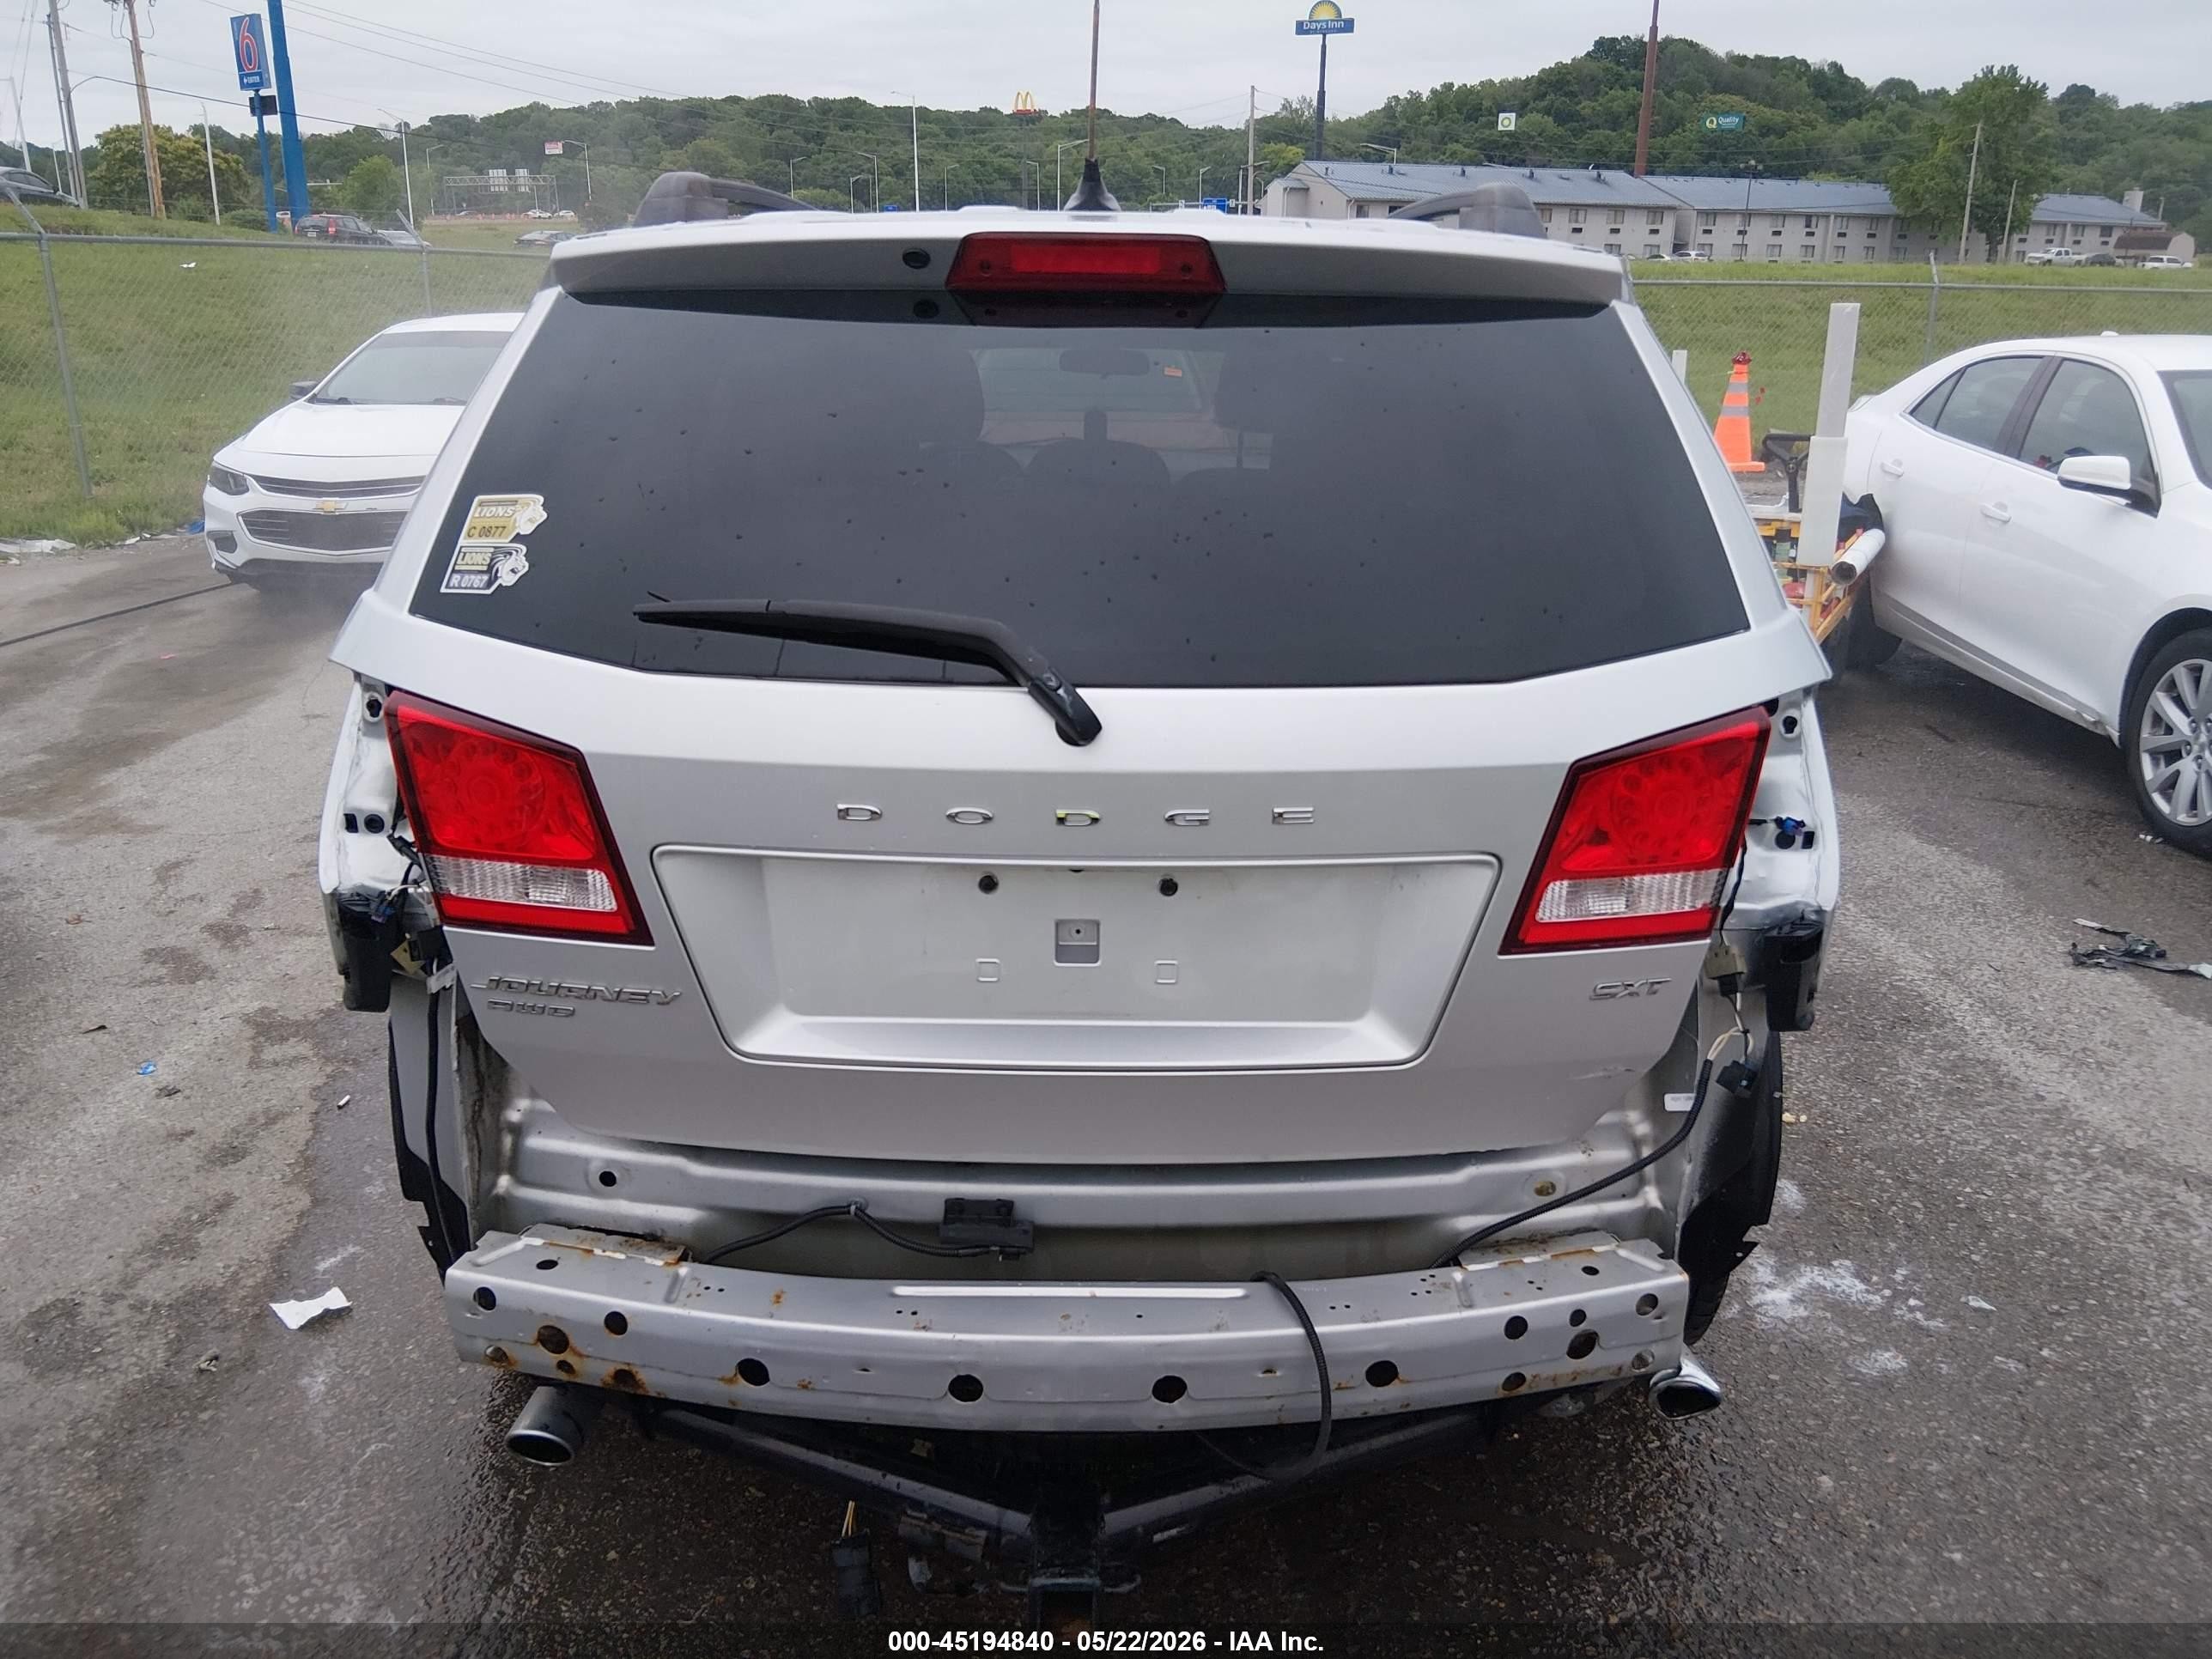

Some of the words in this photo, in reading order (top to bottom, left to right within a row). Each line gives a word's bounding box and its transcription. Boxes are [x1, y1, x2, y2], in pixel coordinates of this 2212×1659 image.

[1303, 21, 1327, 30] Days
[1328, 20, 1345, 28] Inn
[240, 17, 258, 72] 6
[1718, 116, 1740, 125] Quality
[473, 506, 516, 518] LIONS
[467, 526, 477, 538] C
[478, 526, 507, 538] 0877
[456, 552, 492, 565] LIONS
[449, 574, 461, 587] R
[461, 574, 489, 588] 0767
[837, 803, 1315, 825] DODGE
[471, 976, 683, 1006] JOURNEY
[1589, 977, 1673, 1000] SXT
[487, 999, 575, 1017] AWD
